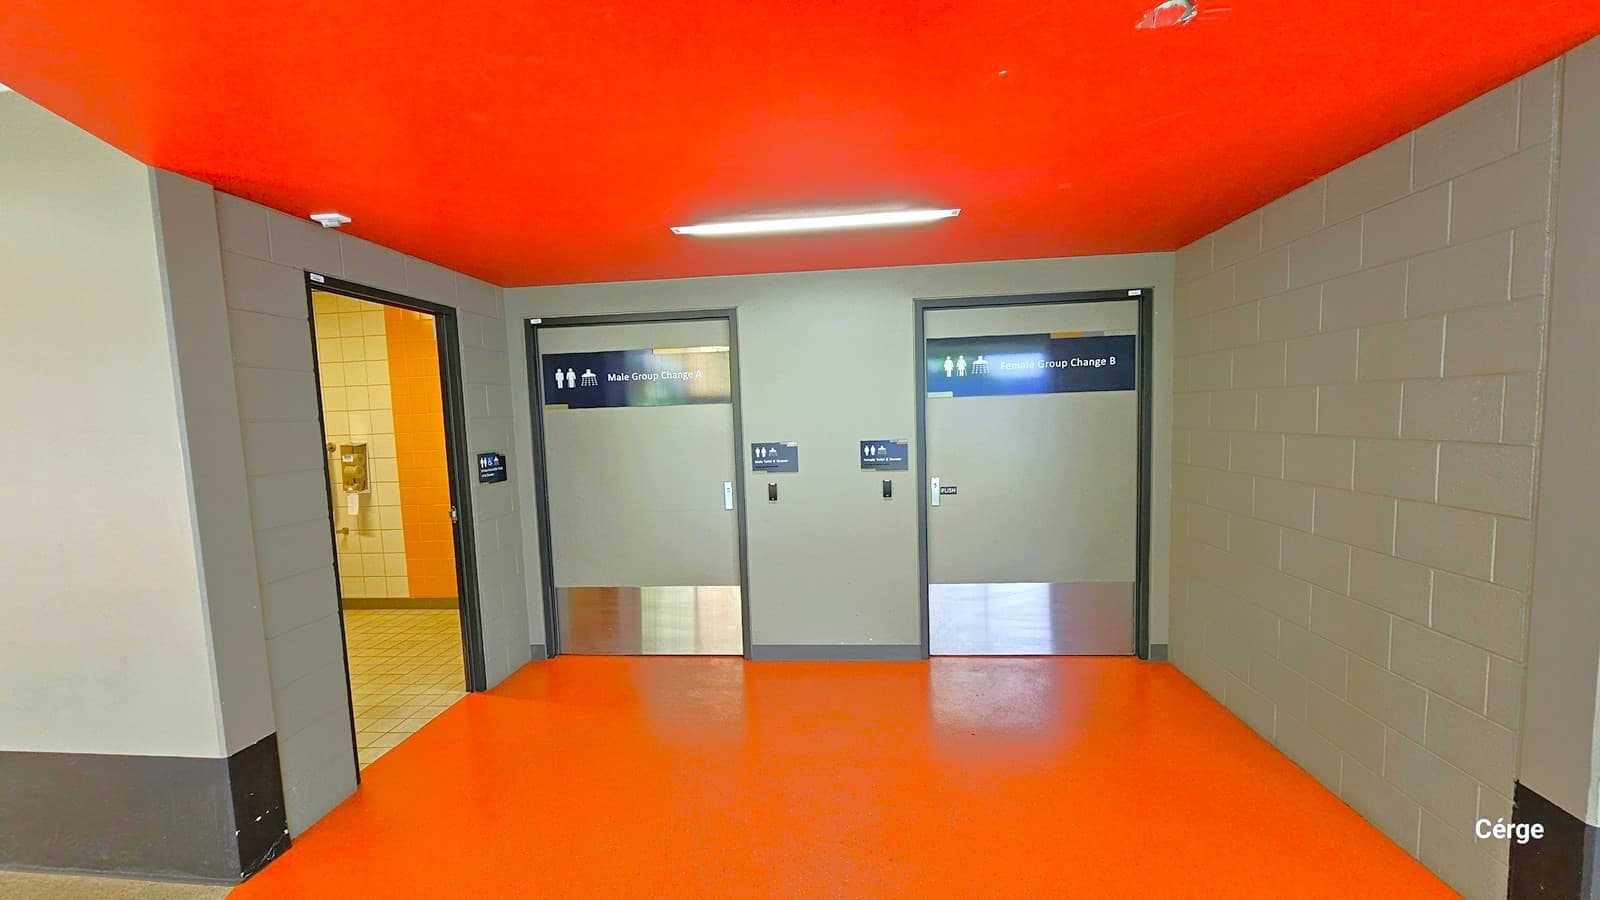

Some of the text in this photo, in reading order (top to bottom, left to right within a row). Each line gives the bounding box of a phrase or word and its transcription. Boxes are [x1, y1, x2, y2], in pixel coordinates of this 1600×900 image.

[1037, 359, 1068, 369] Group
[1070, 357, 1106, 368] Change
[1109, 356, 1117, 365] B
[607, 368, 704, 382] Male Group Change A
